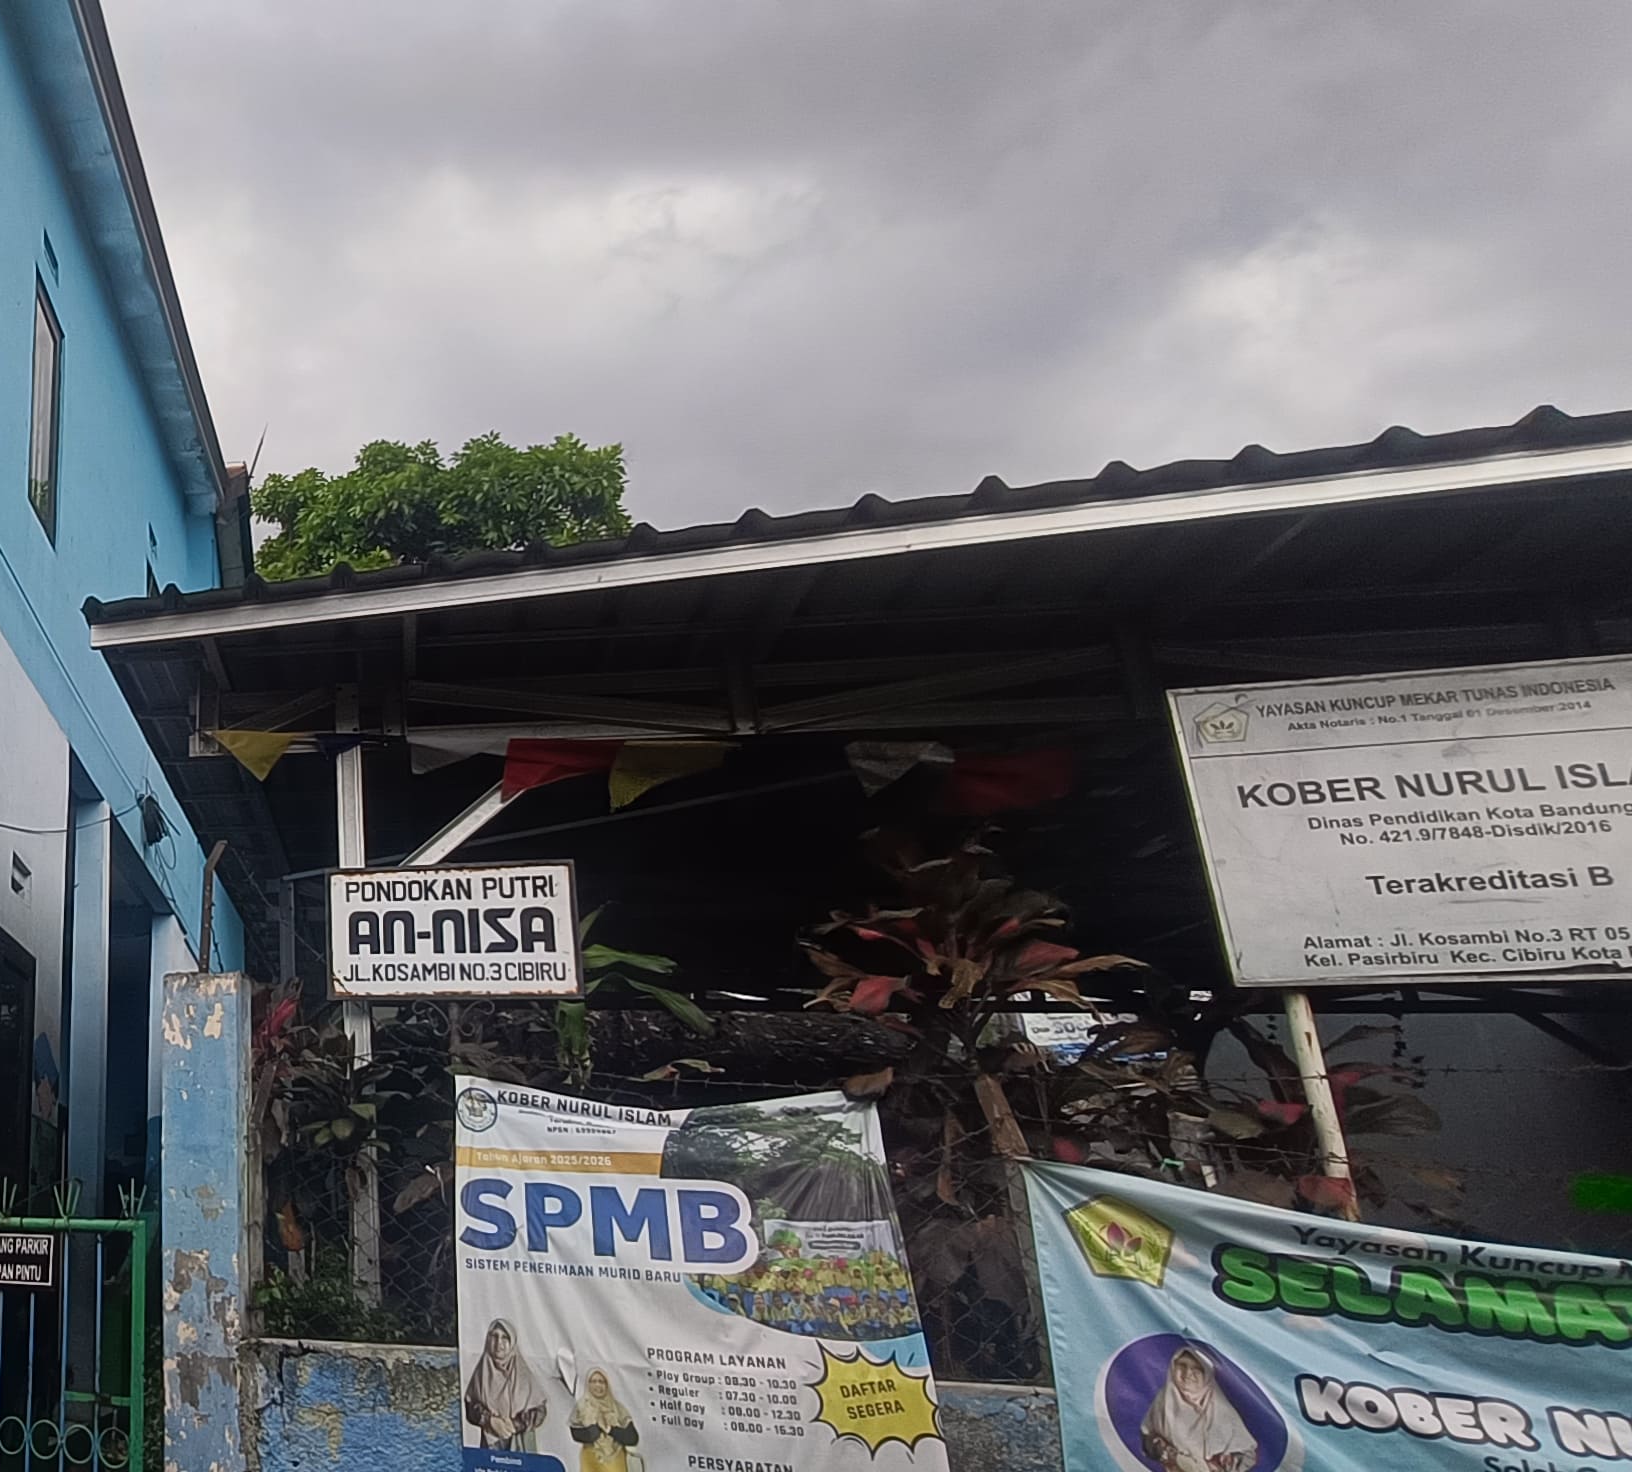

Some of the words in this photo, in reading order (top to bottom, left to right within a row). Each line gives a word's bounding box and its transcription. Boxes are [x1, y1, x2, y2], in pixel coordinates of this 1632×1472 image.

[1256, 700, 1327, 719] YAYASAN
[1330, 695, 1397, 713] KUNCUP
[1400, 690, 1459, 708] MEKAR
[1462, 684, 1518, 702] TUNAS
[1521, 677, 1616, 697] INDONESIA
[1287, 719, 1318, 732] Akta
[1320, 716, 1366, 729] Notaris
[1378, 712, 1407, 725] No.1
[1413, 708, 1464, 724] Tanggal
[1558, 700, 1592, 712] 2014
[1236, 775, 1387, 809] KOBER
[1394, 766, 1546, 799] NURUL
[1554, 761, 1632, 790] ISL
[1307, 815, 1364, 831] Dinas
[1369, 808, 1481, 828] Pendidikan
[1486, 804, 1534, 821] Kota
[1340, 831, 1374, 846] No.
[1379, 818, 1612, 843] 421.9/7848-Disdik/2016
[345, 877, 472, 902] PONDOKAN
[482, 874, 555, 900] PUTRI
[1366, 867, 1579, 896] Terakreditasi
[1587, 865, 1615, 887] B
[348, 906, 557, 955] AN-NISA
[1303, 935, 1372, 950] Alamat
[1389, 933, 1413, 948] Jl.
[1418, 930, 1510, 947] Kosambi
[1515, 928, 1563, 944] No.3
[1569, 926, 1598, 942] RT
[1605, 925, 1631, 941] 05
[1304, 953, 1343, 968] Kel.
[1348, 949, 1439, 966] Pasirbiru
[1451, 949, 1496, 964] Kec.
[1502, 946, 1566, 962] Cibiru
[1572, 945, 1622, 961] Kota
[504, 962, 566, 982] CIBIRU
[497, 1090, 551, 1110] KOBER
[557, 1099, 613, 1119] NURUL
[618, 1111, 672, 1127] ISLAM
[477, 1152, 508, 1163] Tahun
[511, 1154, 548, 1166] Ajaran
[550, 1155, 612, 1166] 2025/2026
[459, 1178, 748, 1264] SPMB
[16, 1238, 49, 1255] PARKIR
[1293, 1225, 1448, 1265] Yayasan
[1460, 1244, 1607, 1280] Kuncup
[16, 1264, 42, 1282] PINTU
[465, 1258, 510, 1272] SISTEM
[514, 1260, 594, 1278] PENERIMAAN
[598, 1265, 641, 1281] MURID
[645, 1269, 682, 1283] BARU
[647, 1347, 715, 1364] PROGRAM
[719, 1354, 787, 1370] LAYANAN
[656, 1370, 679, 1383] Play
[682, 1372, 715, 1386] Group
[724, 1375, 756, 1388] 08.30
[767, 1379, 797, 1390] 10.30
[839, 1379, 897, 1399] DAFTAR
[658, 1384, 700, 1398] Reguler
[725, 1390, 756, 1402] 07.30
[767, 1394, 798, 1405] 10.00
[659, 1399, 682, 1411] Half
[685, 1401, 705, 1415] Day
[771, 1410, 801, 1421] 12.30
[661, 1414, 681, 1426] Full
[684, 1417, 704, 1430] Day
[846, 1399, 906, 1420] SEGERA
[1295, 1373, 1541, 1450] KOBER
